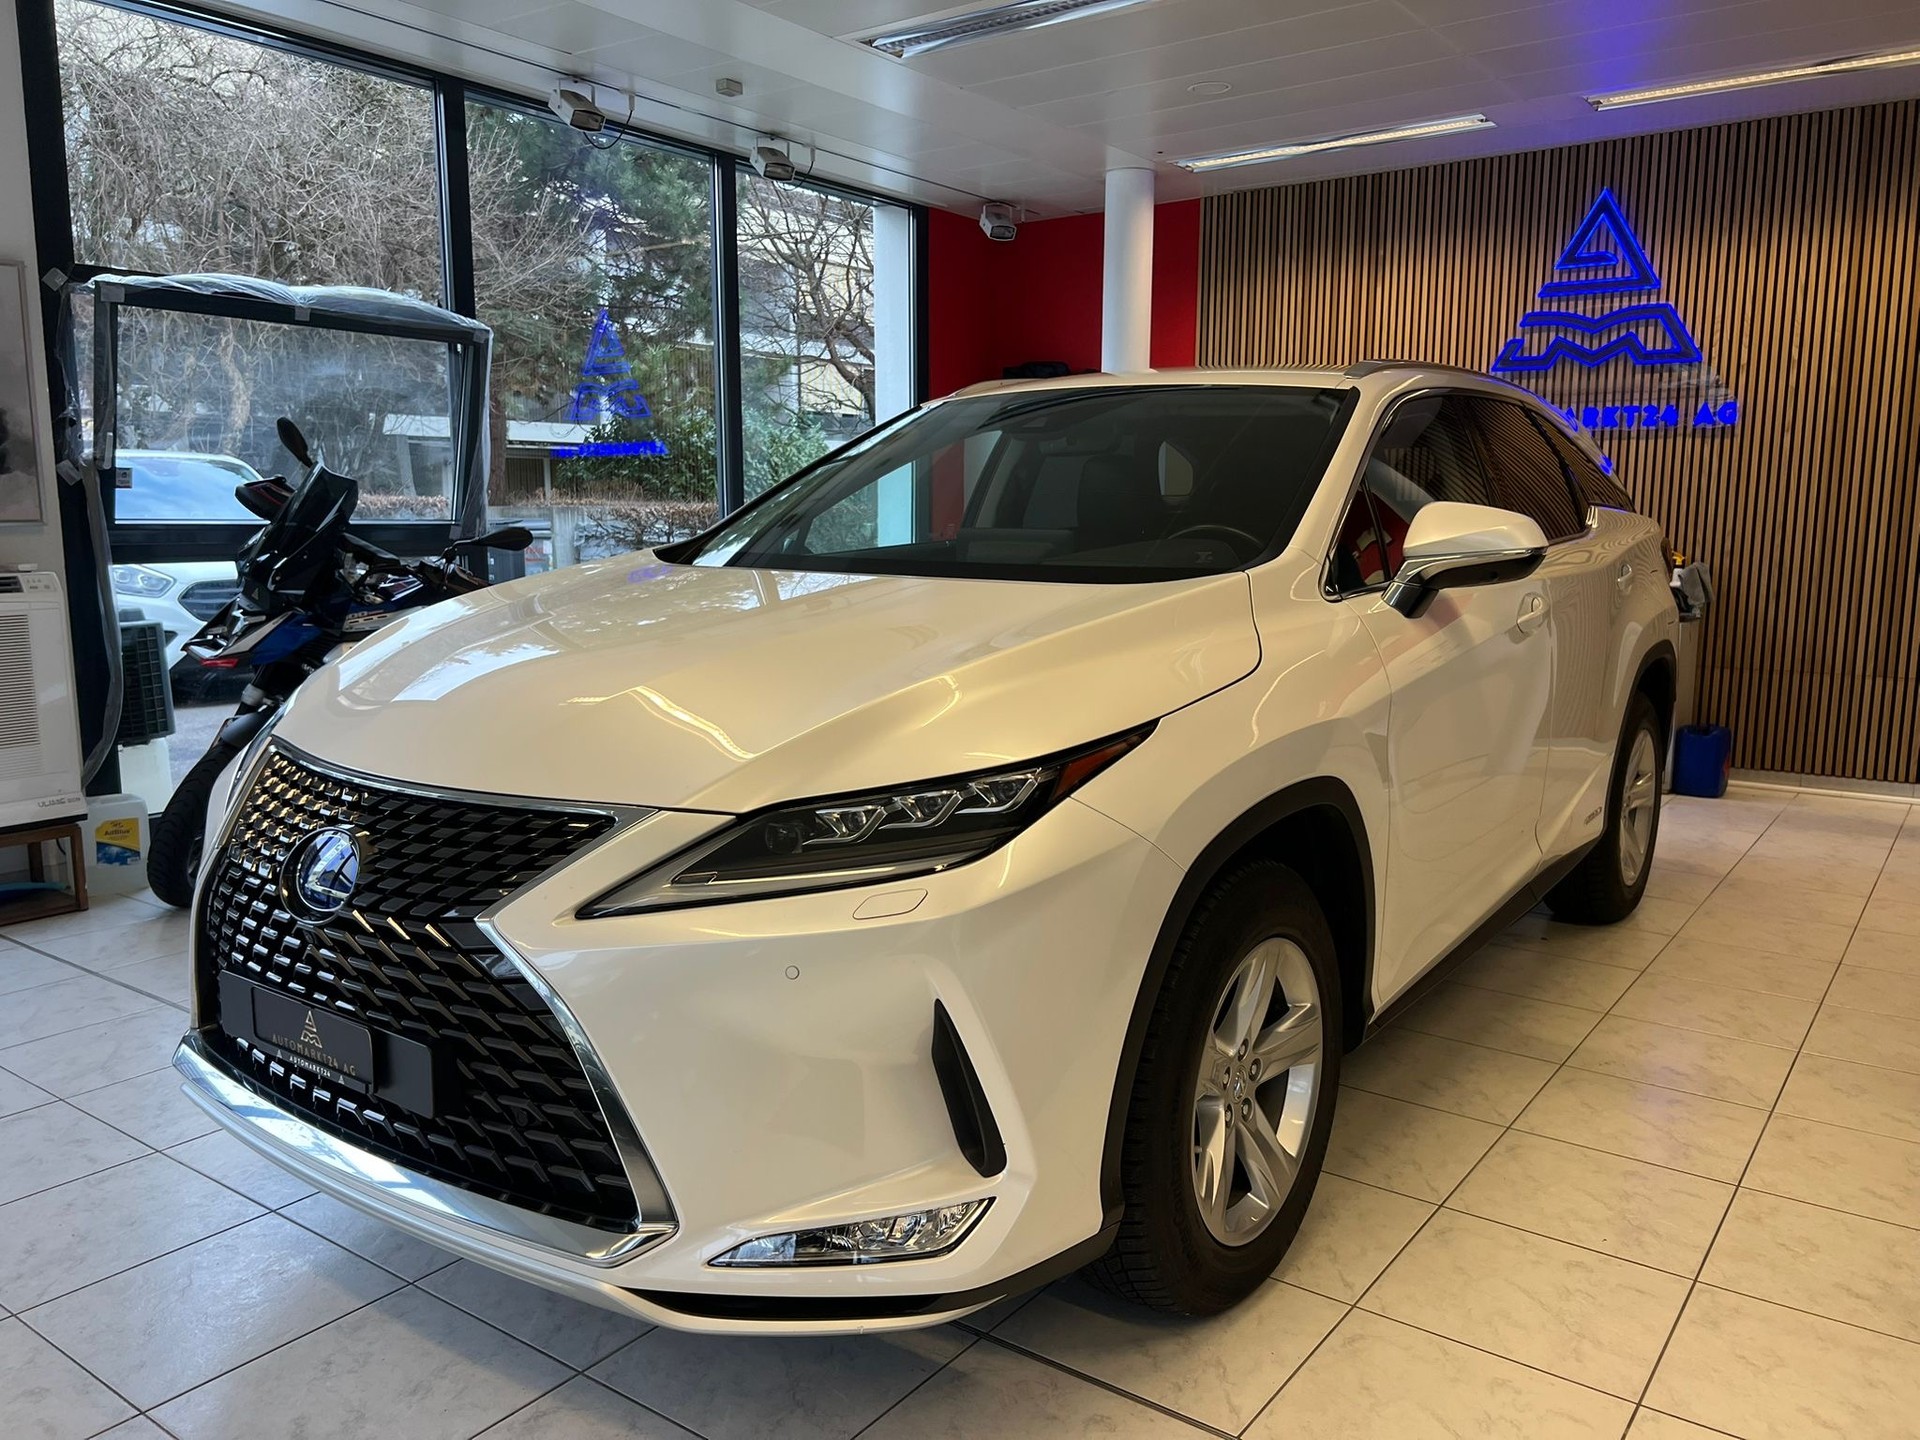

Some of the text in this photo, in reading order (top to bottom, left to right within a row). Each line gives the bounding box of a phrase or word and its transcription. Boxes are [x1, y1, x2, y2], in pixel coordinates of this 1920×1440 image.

[1693, 401, 1738, 427] AG
[272, 1034, 339, 1069] AUTOMARKT24
[289, 1056, 331, 1077] AUTOMARKT24
